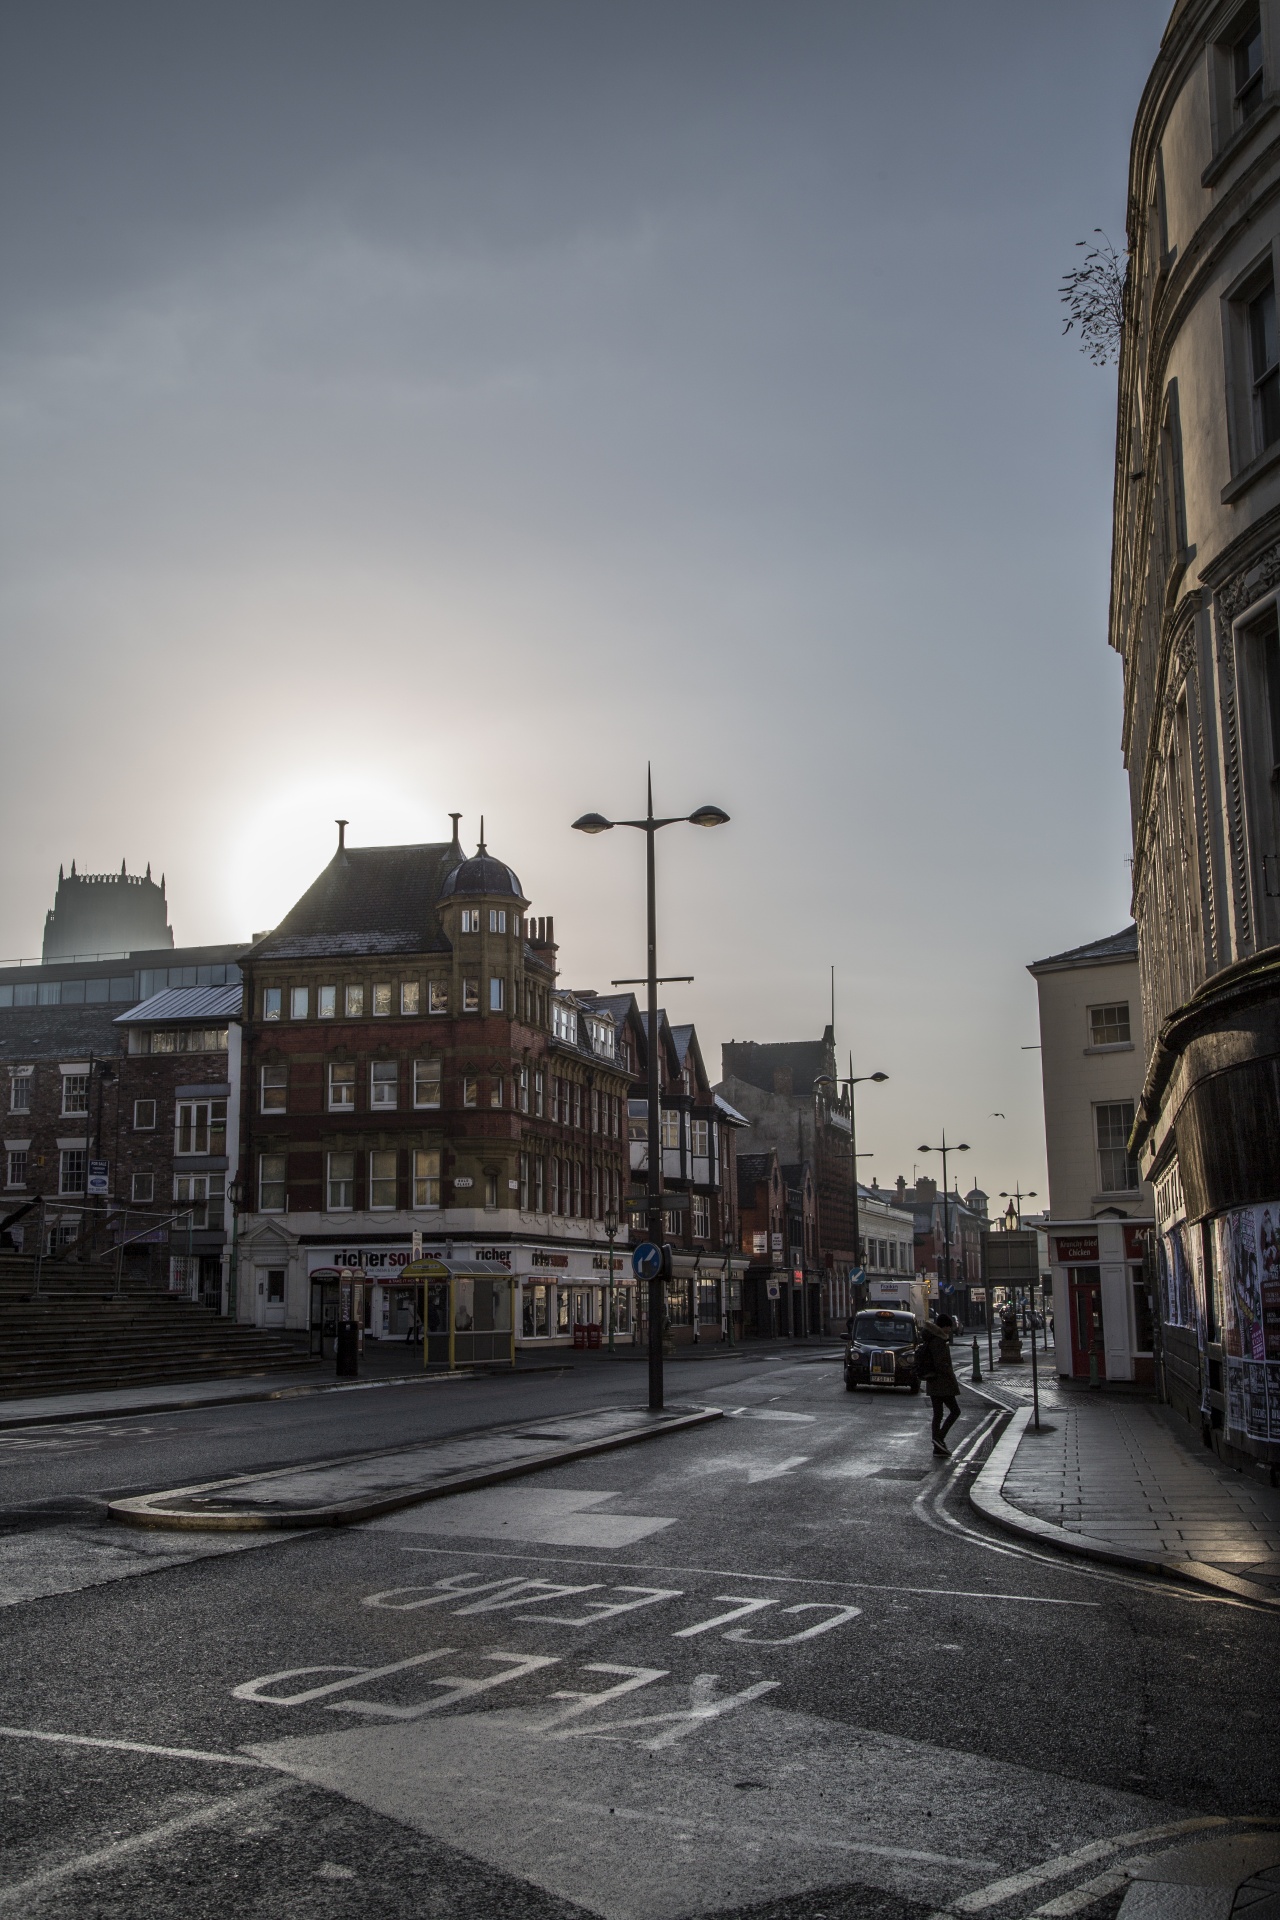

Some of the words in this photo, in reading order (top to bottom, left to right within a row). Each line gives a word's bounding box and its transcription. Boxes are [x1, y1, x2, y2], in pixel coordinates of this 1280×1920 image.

[334, 1249, 388, 1267] richer
[388, 1252, 443, 1267] SOUDS
[475, 1247, 512, 1261] richer
[1068, 1248, 1091, 1257] Chicken
[360, 1571, 864, 1647] CLEAR
[231, 1647, 783, 1752] KEEP
